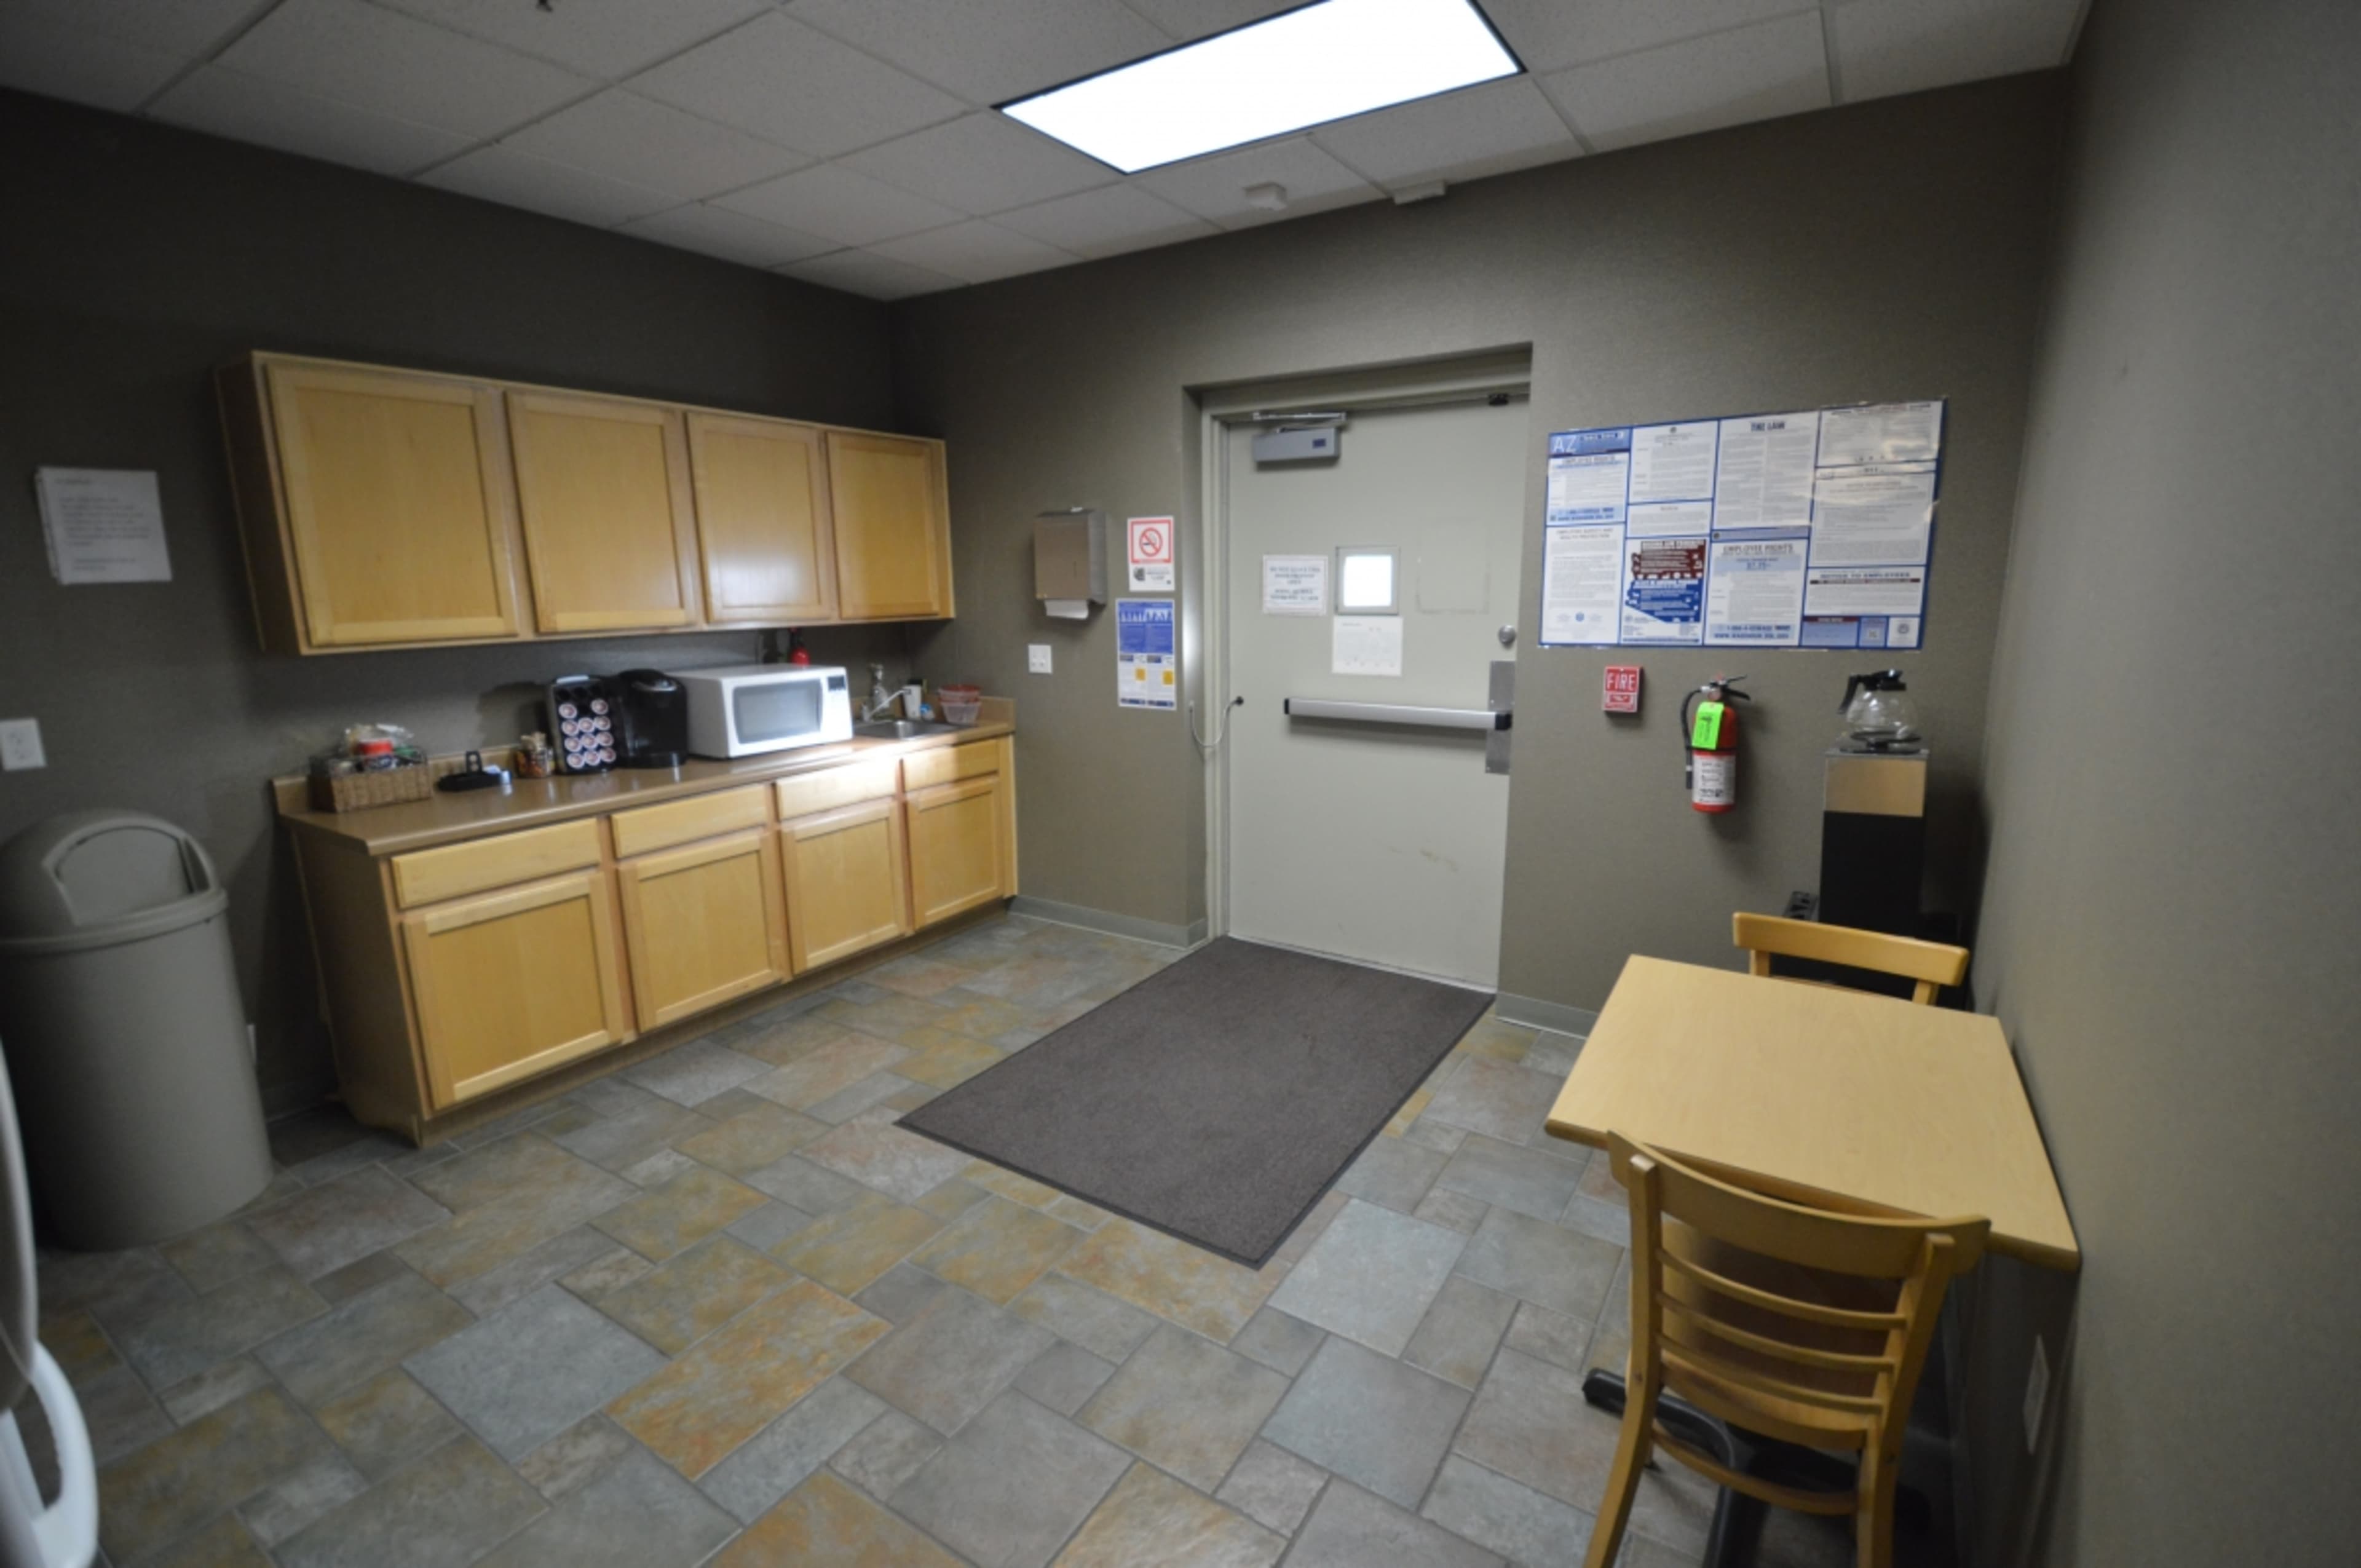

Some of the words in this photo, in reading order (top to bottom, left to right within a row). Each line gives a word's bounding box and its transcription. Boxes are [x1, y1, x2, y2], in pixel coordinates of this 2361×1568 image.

[1767, 421, 1786, 430] LAW
[1553, 435, 1576, 453] AZ
[1607, 672, 1635, 691] FIRE
